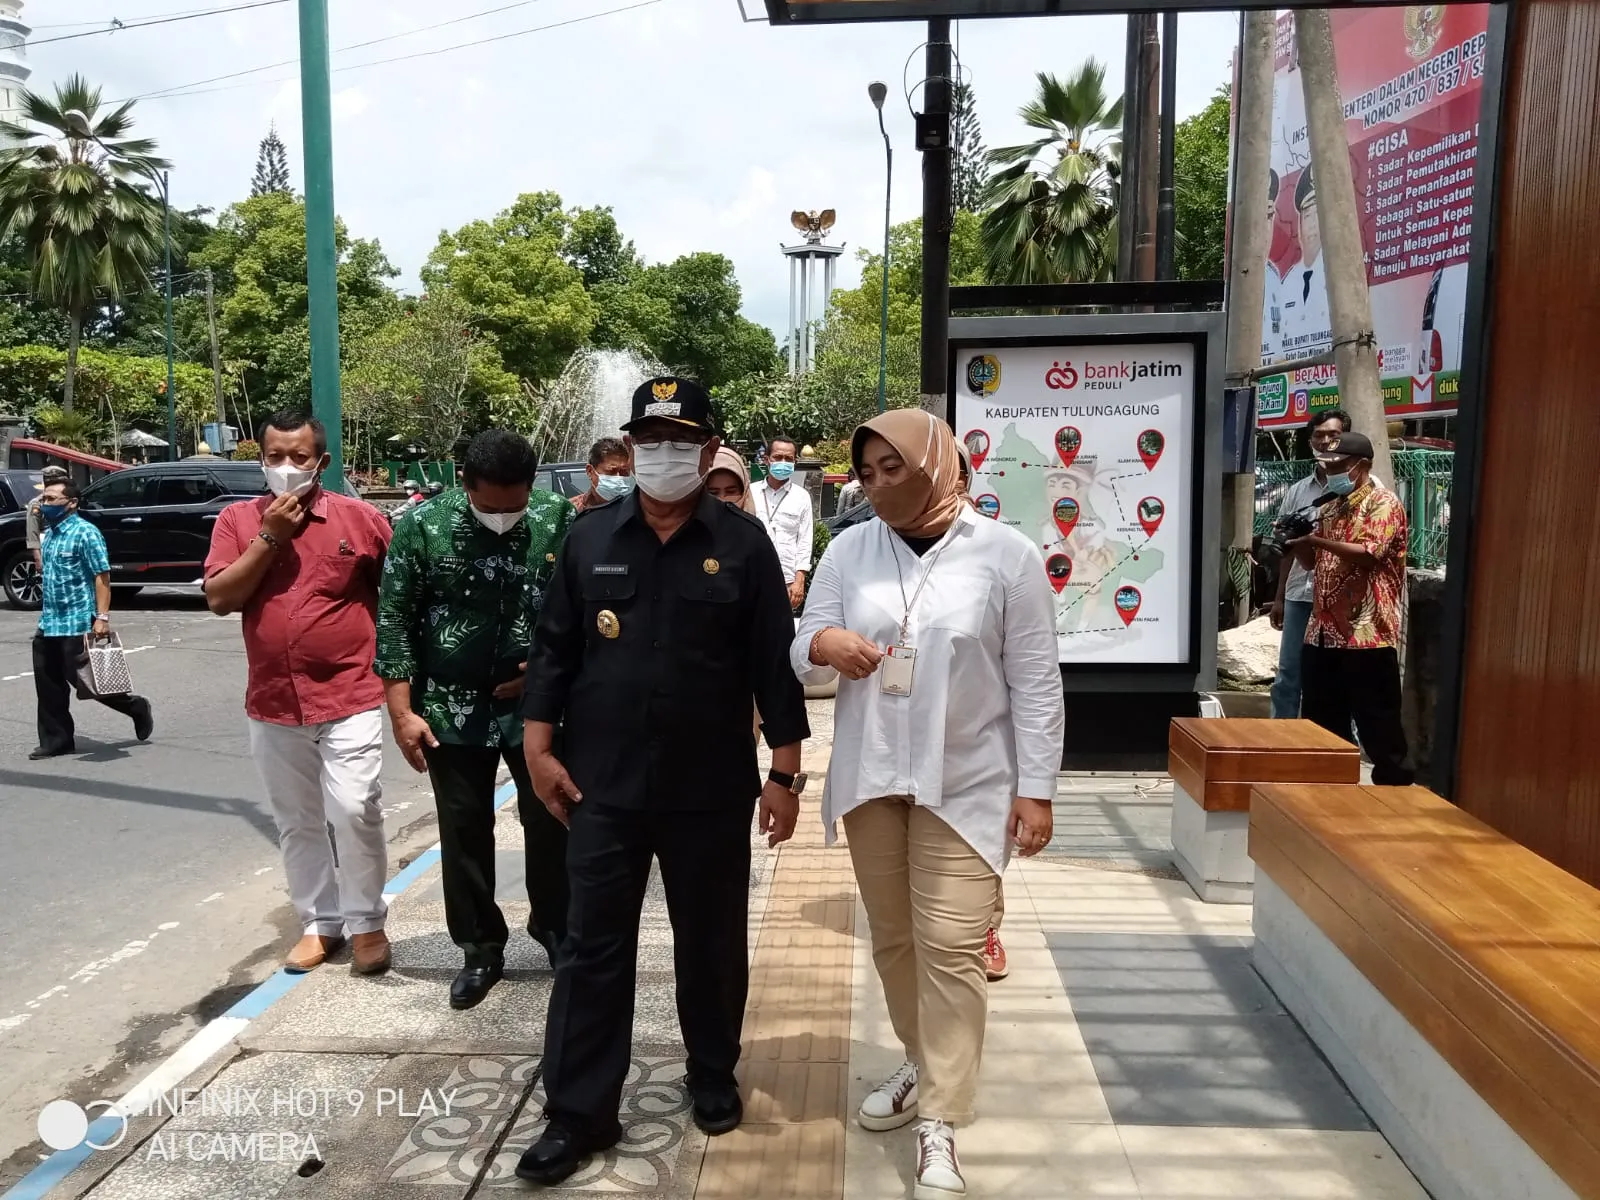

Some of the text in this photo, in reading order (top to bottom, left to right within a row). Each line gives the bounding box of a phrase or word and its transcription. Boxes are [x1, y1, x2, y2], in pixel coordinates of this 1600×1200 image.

[1343, 92, 1376, 118] ENTERI
[1379, 70, 1415, 102] DALAM
[1418, 46, 1459, 82] NEGERI
[1363, 101, 1401, 130] NOMOR
[1404, 84, 1426, 108] 470
[1428, 79, 1435, 102] /
[1437, 68, 1460, 95] 837
[1462, 60, 1469, 86] /
[1367, 128, 1409, 161] #GISA
[1367, 130, 1471, 180] 1. Sadar Kepemilikan
[1366, 145, 1477, 197] 2. Sadar Pemutakhiran
[1365, 167, 1473, 214] 3. Sadar Pemanfaatan
[1375, 203, 1413, 227] Sebagai
[1375, 225, 1402, 243] Untuk
[1405, 215, 1439, 234] Semua
[1363, 252, 1371, 264] 4.
[1374, 244, 1400, 261] Sadar
[1403, 228, 1448, 252] Melayani
[1373, 241, 1470, 278] Menuju Masyarakat
[1084, 361, 1182, 382] bankjatim
[1084, 381, 1122, 390] PEDULI
[985, 404, 1160, 419] KABUPATEN TULUNGAGUNG
[1265, 396, 1283, 409] Kami
